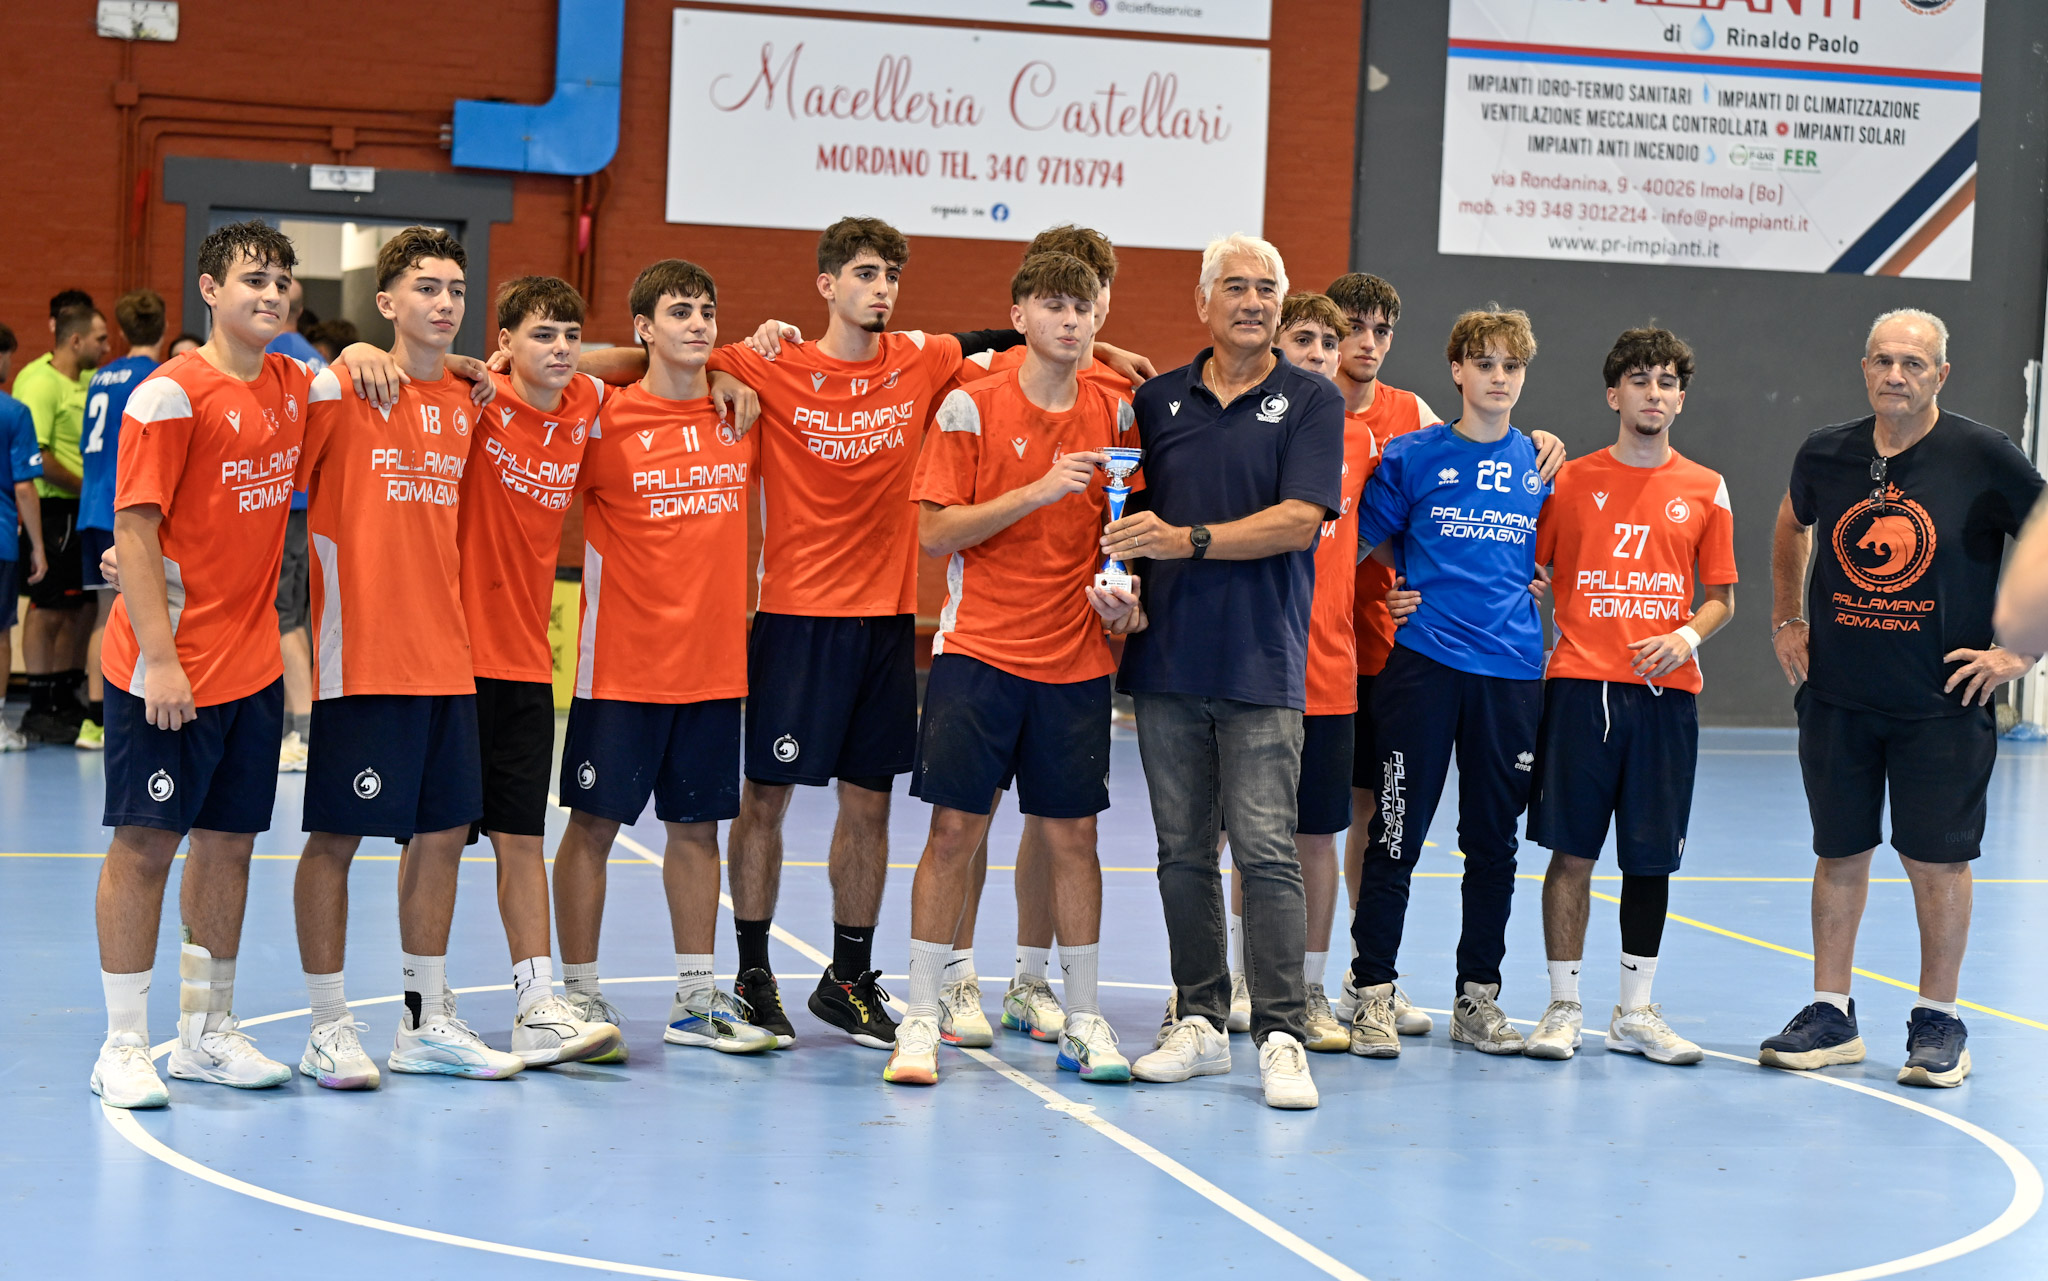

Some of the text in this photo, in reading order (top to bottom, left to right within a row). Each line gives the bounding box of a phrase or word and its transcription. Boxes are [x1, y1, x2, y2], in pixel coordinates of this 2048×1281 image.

[1663, 24, 1859, 54] di Rinaldo Paolo
[709, 41, 1232, 145] Macelleria Castellari
[1468, 74, 1692, 105] IMPIANTI IDRO-TERMO SANITARI
[1718, 90, 1921, 119] IMPIANTI DI CLIMATIZZAZIONE
[1481, 103, 1768, 137] VENTILAZIONE MECCANICA CONTROLLATA
[1794, 122, 1906, 145] IMPIANTI SOLARI
[1528, 135, 1700, 162] IMPIANTI ANTI INCENDIO
[1783, 148, 1818, 167] FER
[816, 144, 1125, 188] MORDANO TEL. 340 9718794
[1491, 171, 1516, 187] via
[1520, 173, 1612, 194] Rondanina,
[1617, 176, 1628, 194] 9
[1642, 178, 1696, 197] 40026
[1701, 183, 1744, 201] Imola
[1458, 199, 1499, 216] mob.
[1504, 202, 1536, 218] +39
[1541, 202, 1574, 220] 348
[1578, 203, 1649, 224] 3012214
[1661, 207, 1810, 234] info@pr-impianti.it
[1548, 234, 1720, 259] www.pr-impianti.it
[850, 378, 869, 396] 17
[85, 391, 109, 454] 2
[420, 399, 441, 435] 18
[542, 420, 559, 447] 7
[682, 425, 700, 453] 11
[808, 428, 905, 460] ROMAGNA
[371, 448, 467, 479] PALLAMAN
[485, 436, 580, 484] PALLAMA
[633, 462, 747, 493] PALLAMANO
[1476, 460, 1512, 493] 22
[239, 478, 295, 514] ROMAG
[386, 480, 458, 507] ROMAGNA
[649, 492, 739, 519] ROMAGNA
[1440, 523, 1527, 546] ROMAGNA
[1612, 523, 1650, 560] 27
[1577, 569, 1685, 594] PALLAMAN
[1589, 597, 1680, 621] ROMAGNA
[1832, 592, 1935, 612] PALLAMANO
[1834, 611, 1921, 632] ROMAGNA
[1378, 761, 1394, 844] ROMAGNA
[1389, 750, 1407, 860] PALLAMANO
